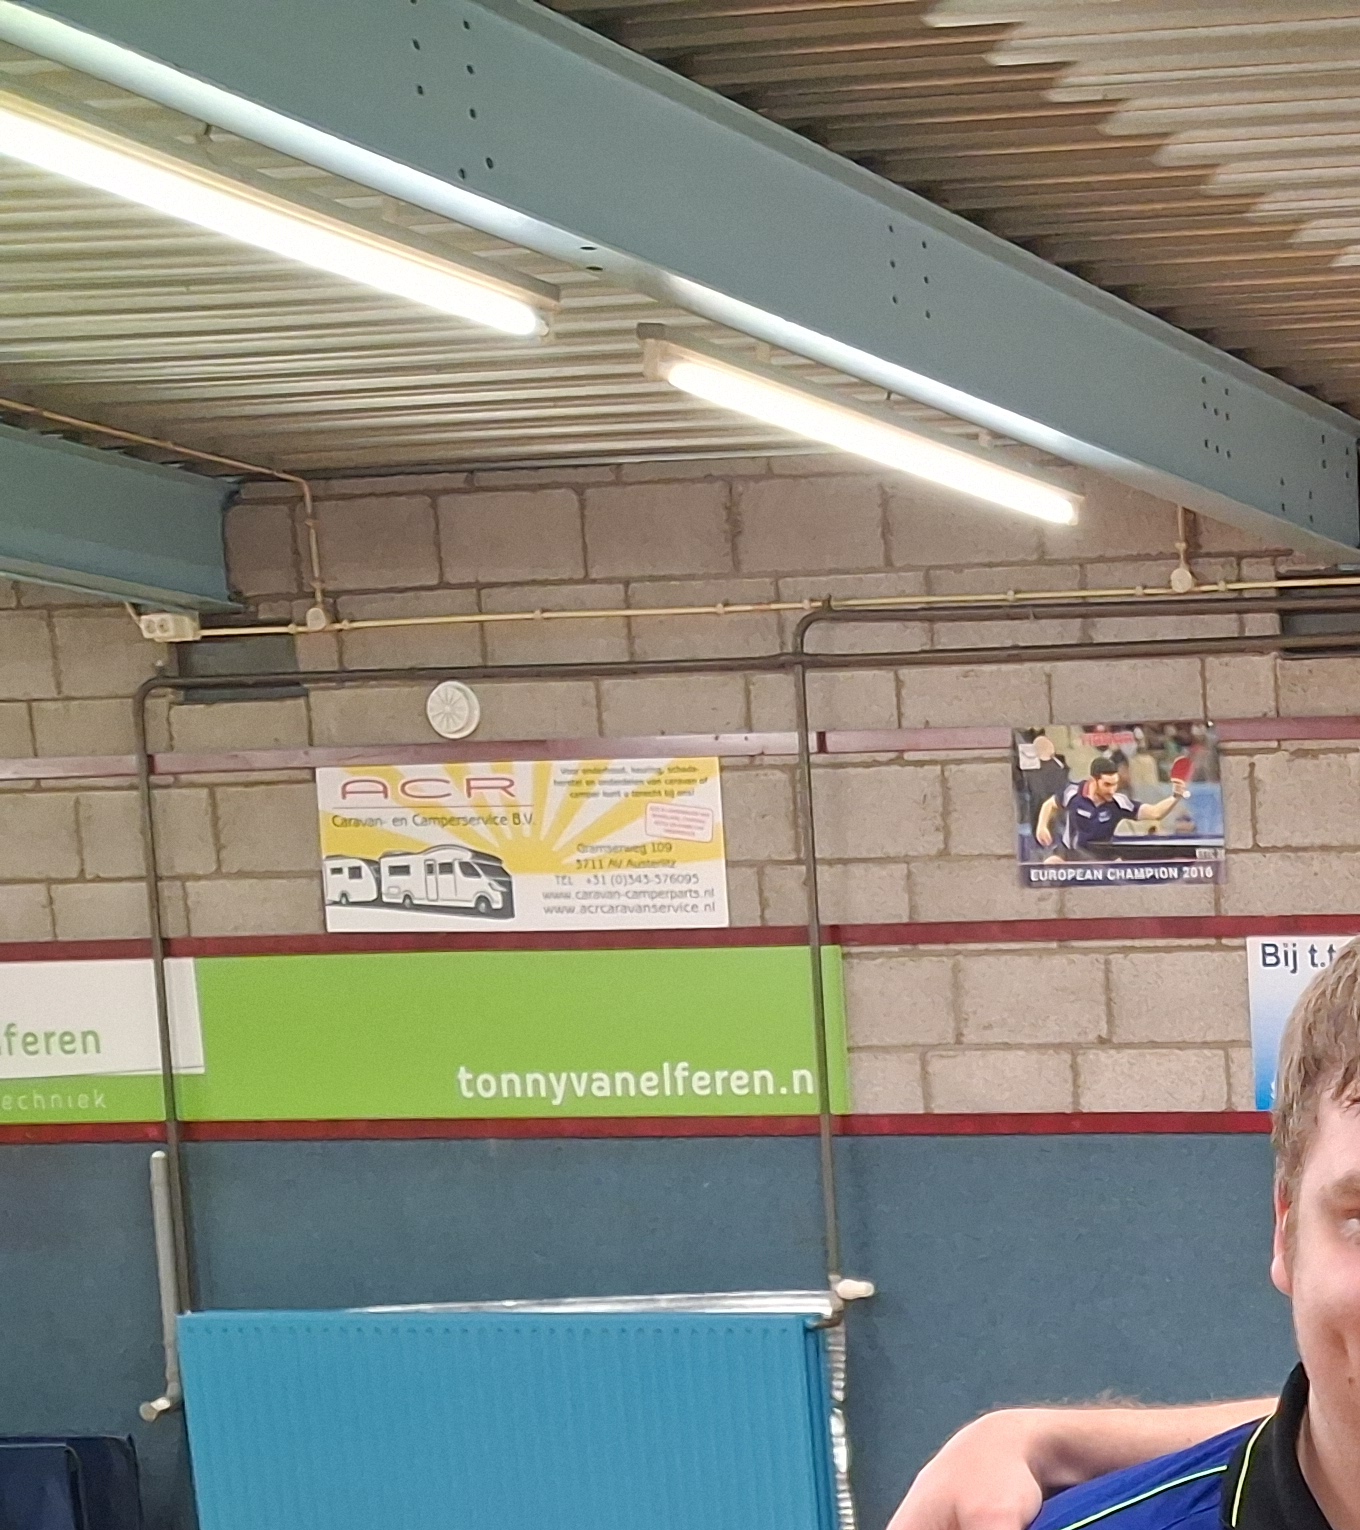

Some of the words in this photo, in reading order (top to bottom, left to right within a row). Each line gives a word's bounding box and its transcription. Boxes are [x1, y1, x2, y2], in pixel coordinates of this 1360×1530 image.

[341, 777, 516, 799] ACR
[392, 816, 407, 827] en
[412, 813, 508, 829] Camperservice
[652, 842, 673, 852] 109
[1030, 868, 1102, 882] EUROPEAN
[1107, 868, 1178, 881] CHAMPION
[1183, 866, 1213, 879] 2016
[1261, 943, 1297, 974] Bij
[0, 1022, 102, 1056] feren
[456, 1061, 815, 1106] tonnyvanelferen.n
